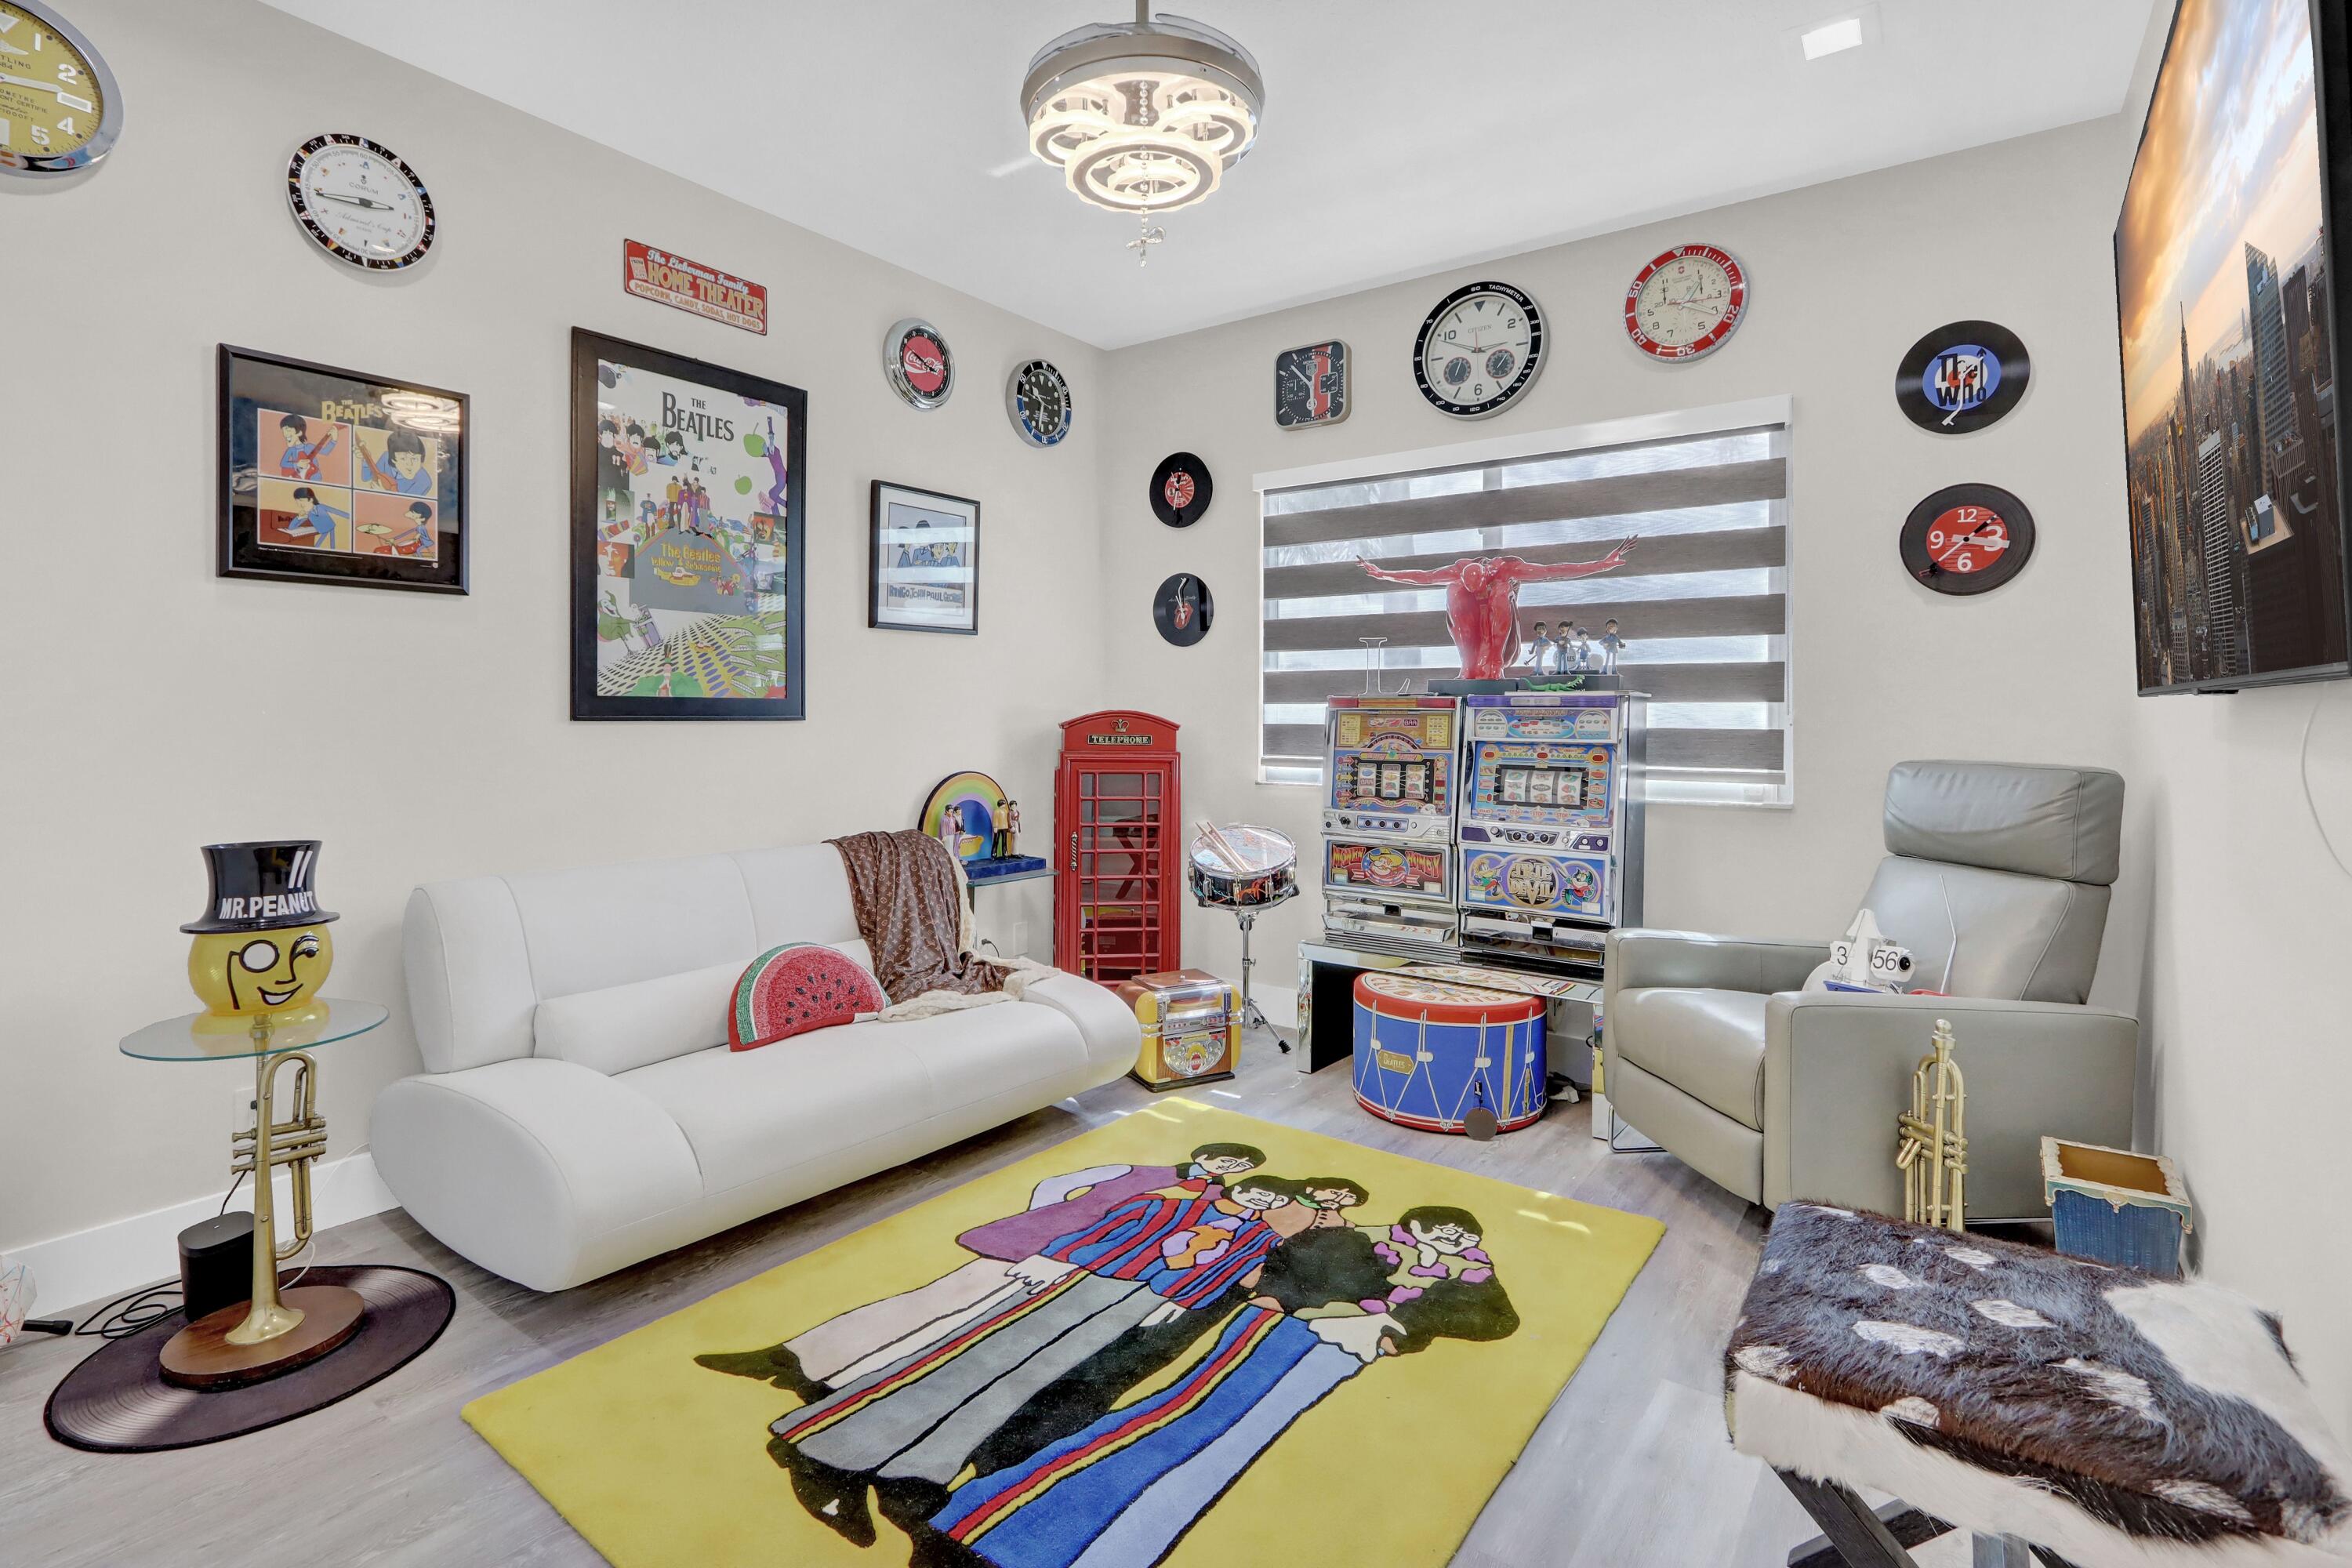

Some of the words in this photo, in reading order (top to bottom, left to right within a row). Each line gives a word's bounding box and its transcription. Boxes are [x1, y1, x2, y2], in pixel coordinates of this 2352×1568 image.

[34, 33, 41, 51] 1
[1, 55, 31, 69] TLING
[57, 64, 77, 85] 2
[0, 89, 36, 103] OMETRE
[56, 117, 74, 136] 4
[31, 125, 49, 146] 5
[349, 182, 379, 195] CORUM
[647, 249, 666, 264] The
[648, 260, 694, 296] HOME
[696, 277, 764, 320] THEATER
[1488, 285, 1523, 302] TACHYMETER
[1629, 281, 1642, 298] 50
[1723, 304, 1740, 323] 20
[742, 318, 761, 329] DOGS
[1468, 324, 1492, 334] CITIZEN
[1507, 318, 1516, 329] 2
[1652, 321, 1660, 330] 8
[1697, 321, 1706, 330] 5
[1443, 329, 1457, 340] 10
[1632, 328, 1647, 346] 40
[1667, 329, 1674, 338] 7
[1474, 383, 1483, 396] 6
[691, 397, 706, 410] THE
[321, 401, 383, 426] BEATLES
[662, 391, 735, 442] BEATLES
[1957, 508, 1977, 524] 12
[1929, 530, 1944, 549] 9
[1984, 525, 2003, 552] 3
[661, 542, 681, 559] The
[1957, 552, 1973, 572] 6
[1091, 735, 1149, 744] TELEPHONE
[1332, 844, 1367, 869] MONEY
[1837, 946, 1848, 966] 3
[1872, 949, 1899, 971] 56
[1383, 1053, 1406, 1069] BEATLES
